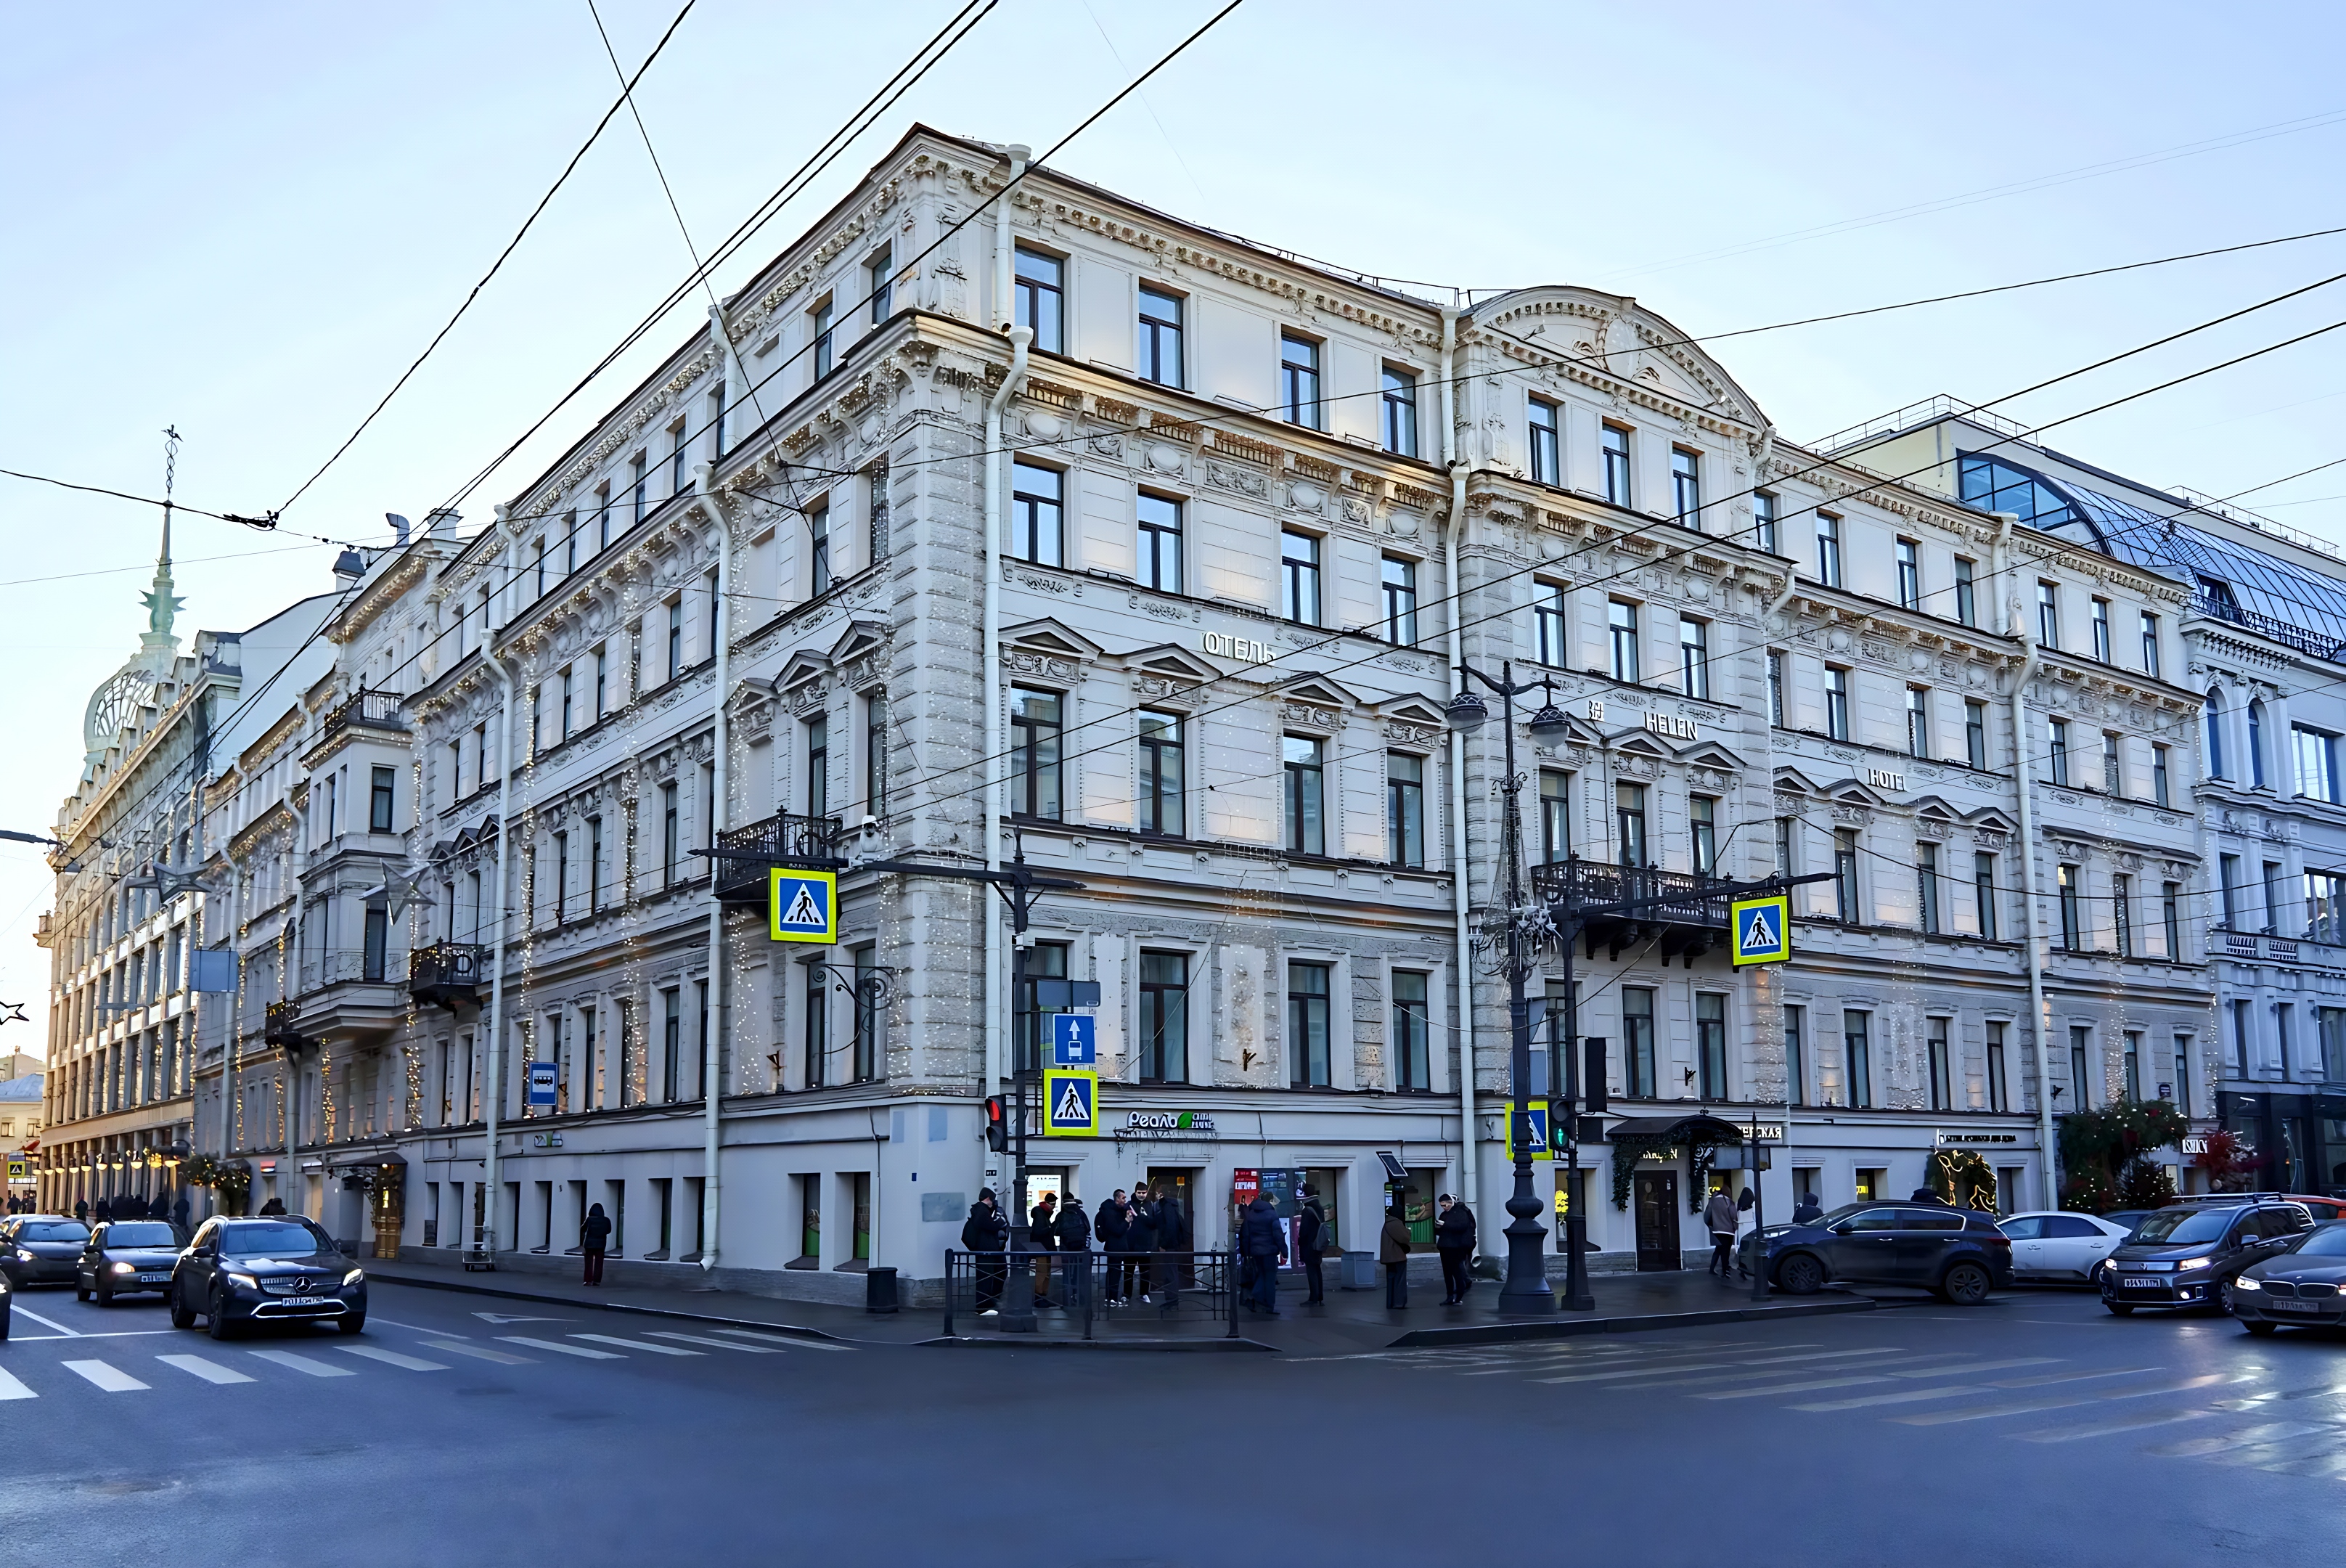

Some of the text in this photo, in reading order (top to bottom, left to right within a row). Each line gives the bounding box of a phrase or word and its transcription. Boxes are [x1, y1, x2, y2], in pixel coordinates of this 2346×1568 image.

[1203, 631, 1278, 666] ОТЕЛЬ
[1644, 711, 1699, 741] HELEN
[1868, 768, 1910, 792] HOTEL
